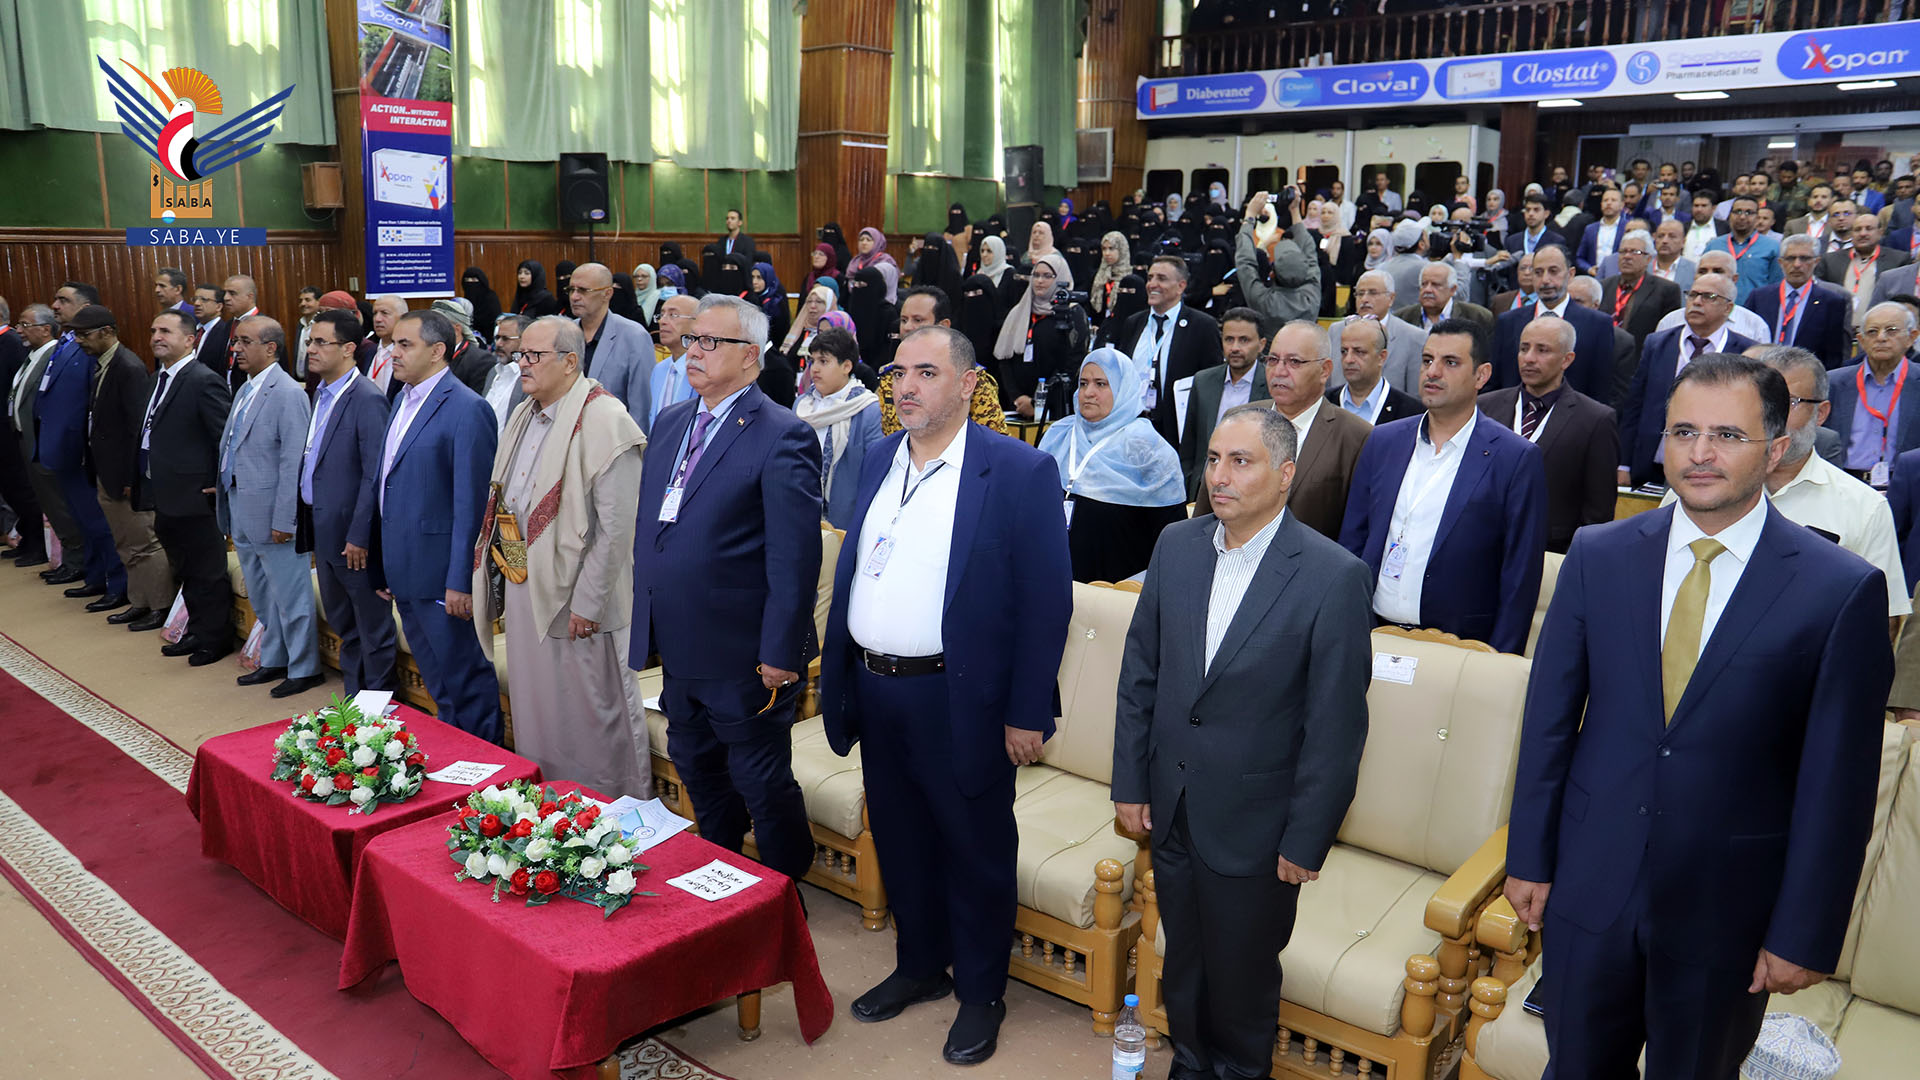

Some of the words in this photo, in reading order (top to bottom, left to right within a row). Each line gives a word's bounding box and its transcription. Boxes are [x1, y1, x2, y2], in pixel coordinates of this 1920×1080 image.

[1801, 42, 1905, 73] Xopan
[1666, 67, 1741, 80] Pharmaceutical
[1332, 76, 1417, 95] Cloval
[390, 116, 448, 128] INTERACTION
